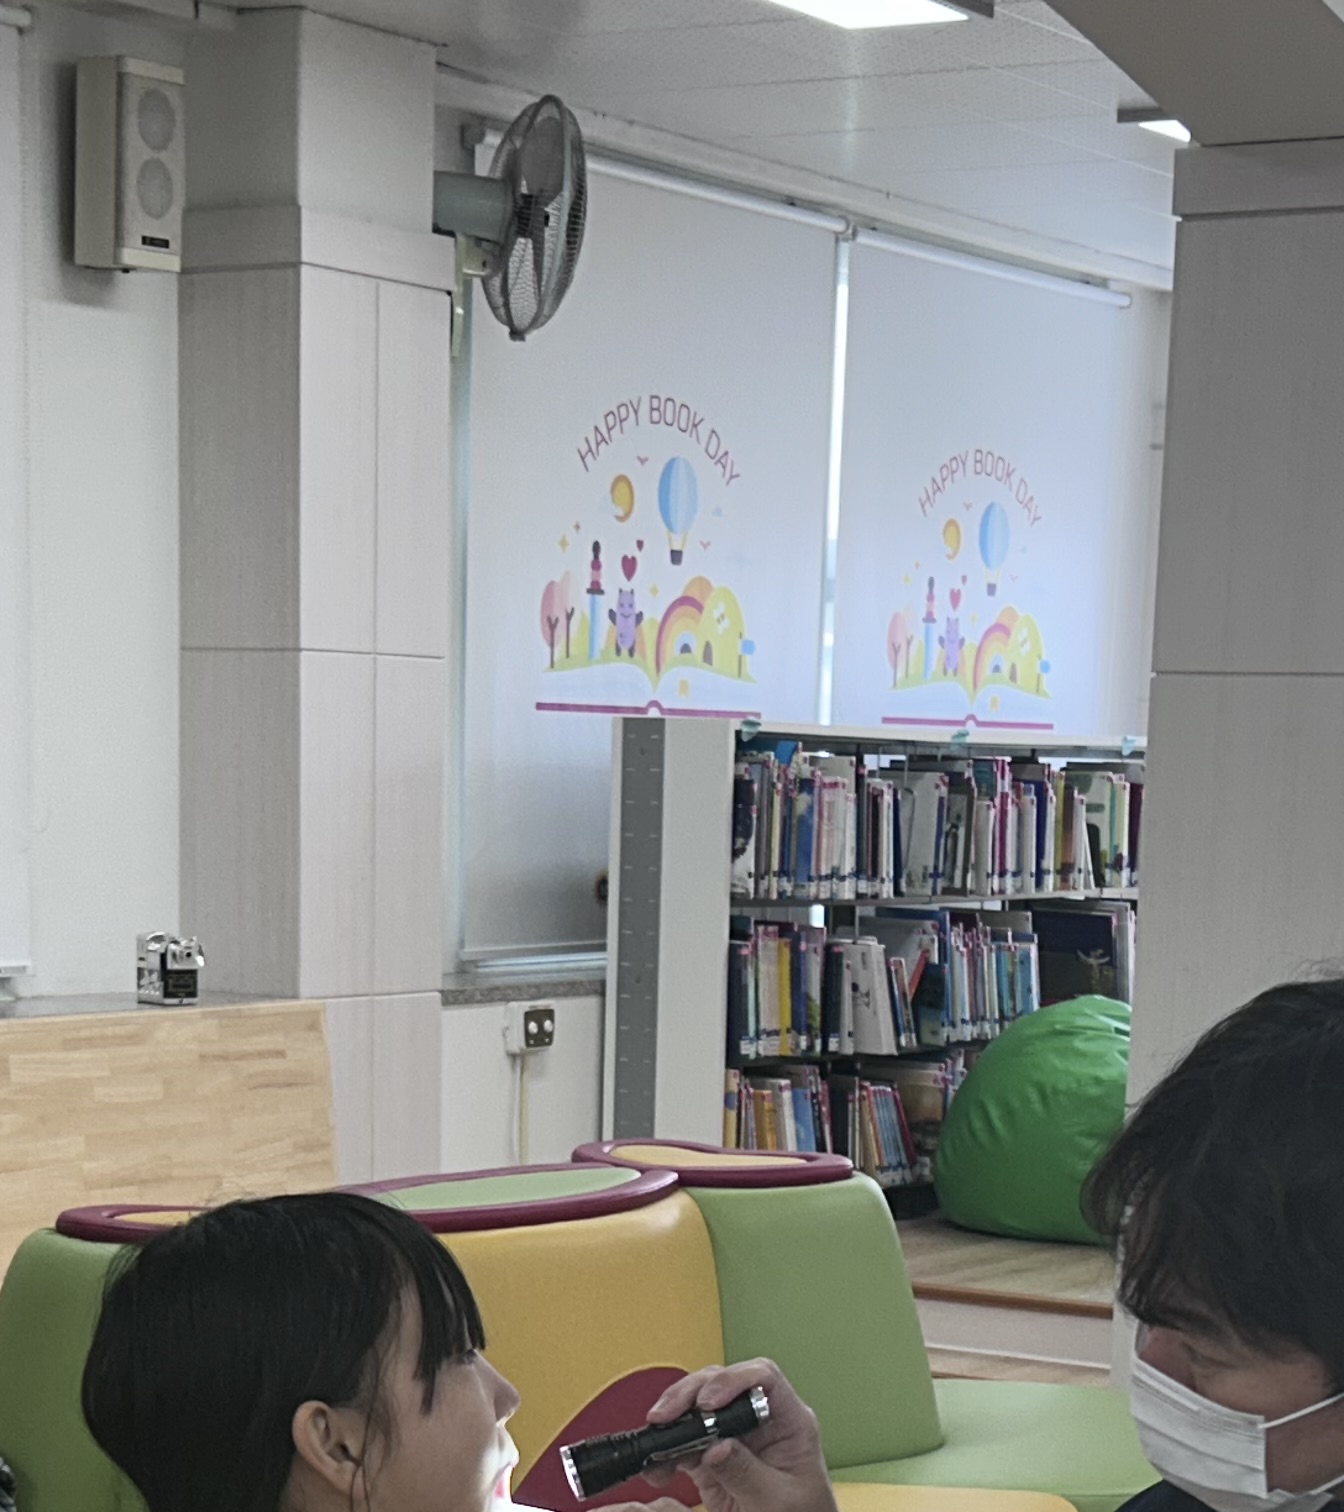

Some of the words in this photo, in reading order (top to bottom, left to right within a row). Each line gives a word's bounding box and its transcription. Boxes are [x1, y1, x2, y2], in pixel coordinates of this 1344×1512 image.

[577, 397, 642, 472] HAPPY
[650, 394, 705, 445] BOOK
[705, 429, 741, 487] DAY
[918, 449, 969, 518] HAPPY
[973, 449, 1017, 491] BOOK
[1015, 478, 1042, 528] DAY
